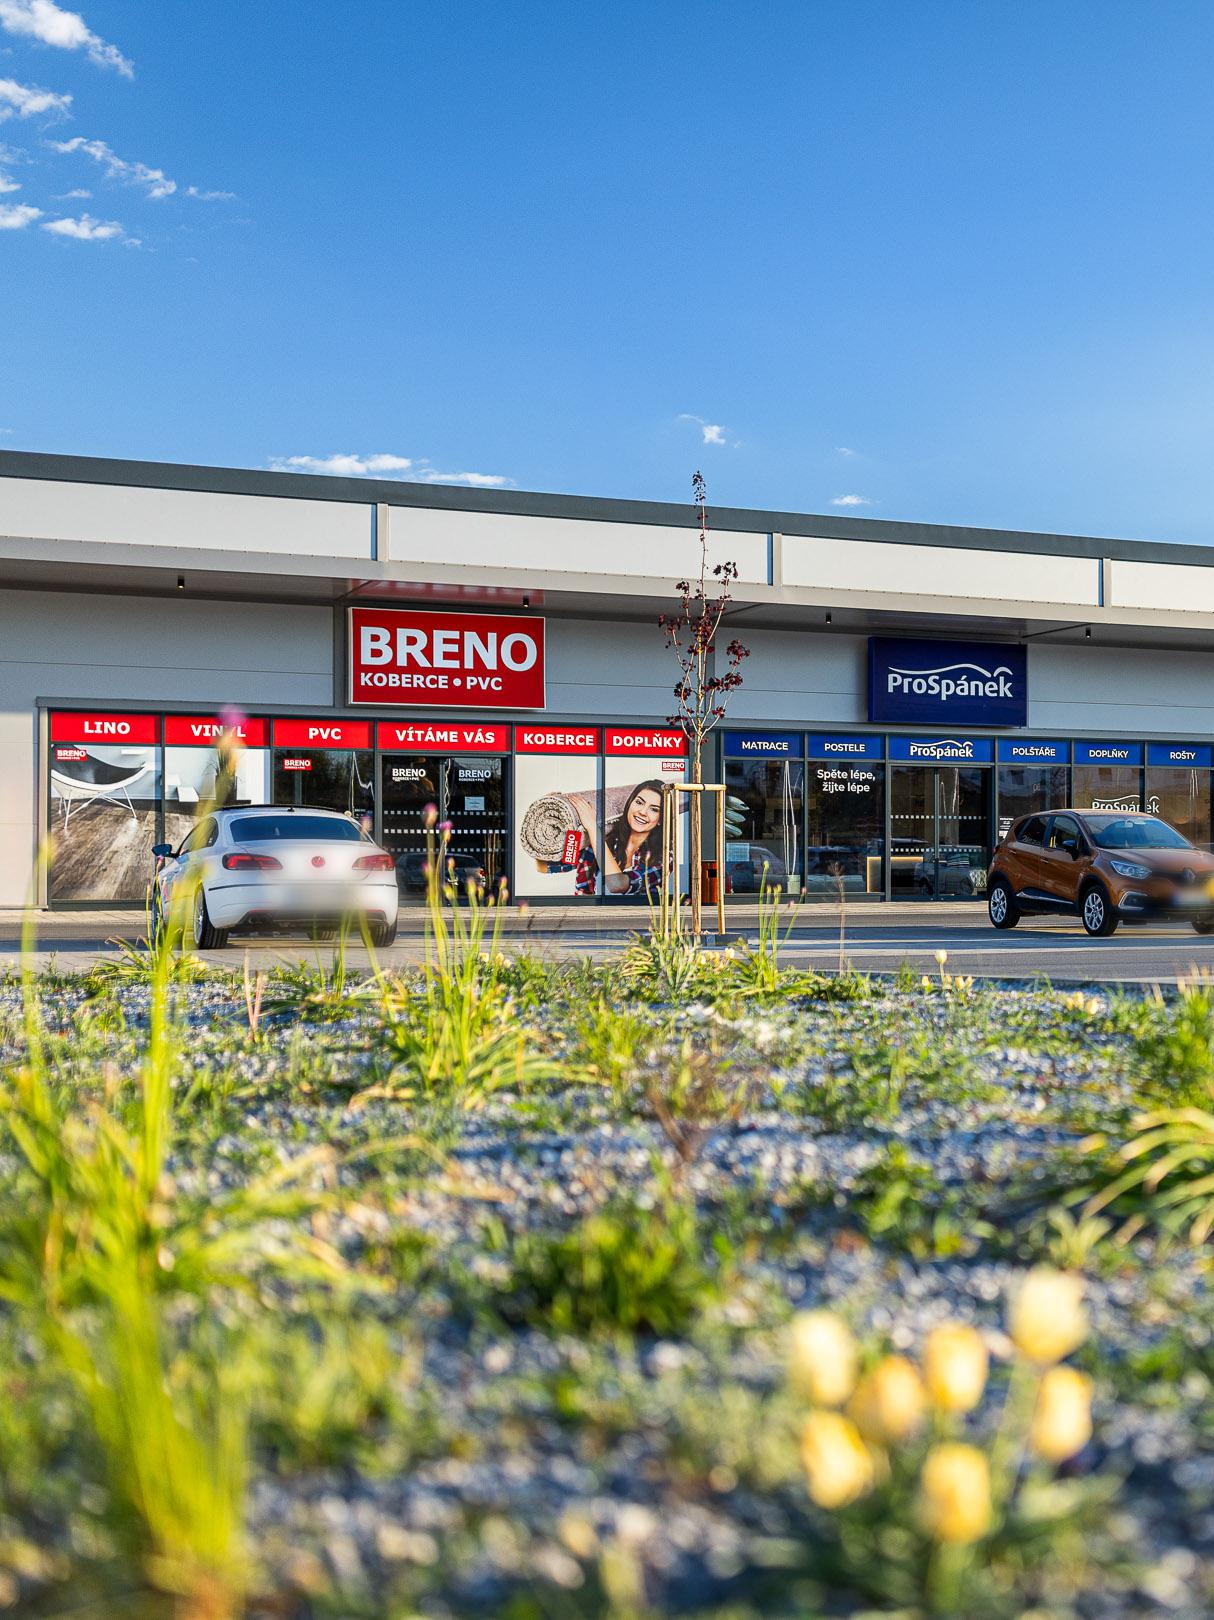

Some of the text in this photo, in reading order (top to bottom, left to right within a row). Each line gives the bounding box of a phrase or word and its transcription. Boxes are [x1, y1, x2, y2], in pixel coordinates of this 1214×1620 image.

[360, 626, 538, 672] BRENO
[360, 672, 503, 691] KOBERCE PVC
[887, 673, 1014, 700] ProSpánek
[84, 721, 131, 735] LINO
[308, 727, 342, 740] PVC
[396, 726, 495, 744] VÍTÁME VÁS
[523, 733, 594, 746] KOBERCE
[612, 733, 683, 748] DOPLŇKY
[741, 741, 789, 751] MATRACE
[824, 743, 866, 753] POSTELE
[909, 745, 974, 760] ProSpánek
[1011, 746, 1056, 757] POLŠTÁŘE
[57, 749, 87, 757] BRENO
[1088, 748, 1129, 759] DOPLŇKY
[1169, 750, 1196, 760] ROŠTY
[392, 768, 426, 777] BRENO
[458, 769, 491, 778] BRENO
[816, 768, 876, 782] Spěte lépe,
[822, 781, 871, 794] žijte lépe
[564, 834, 576, 863] BRENO
